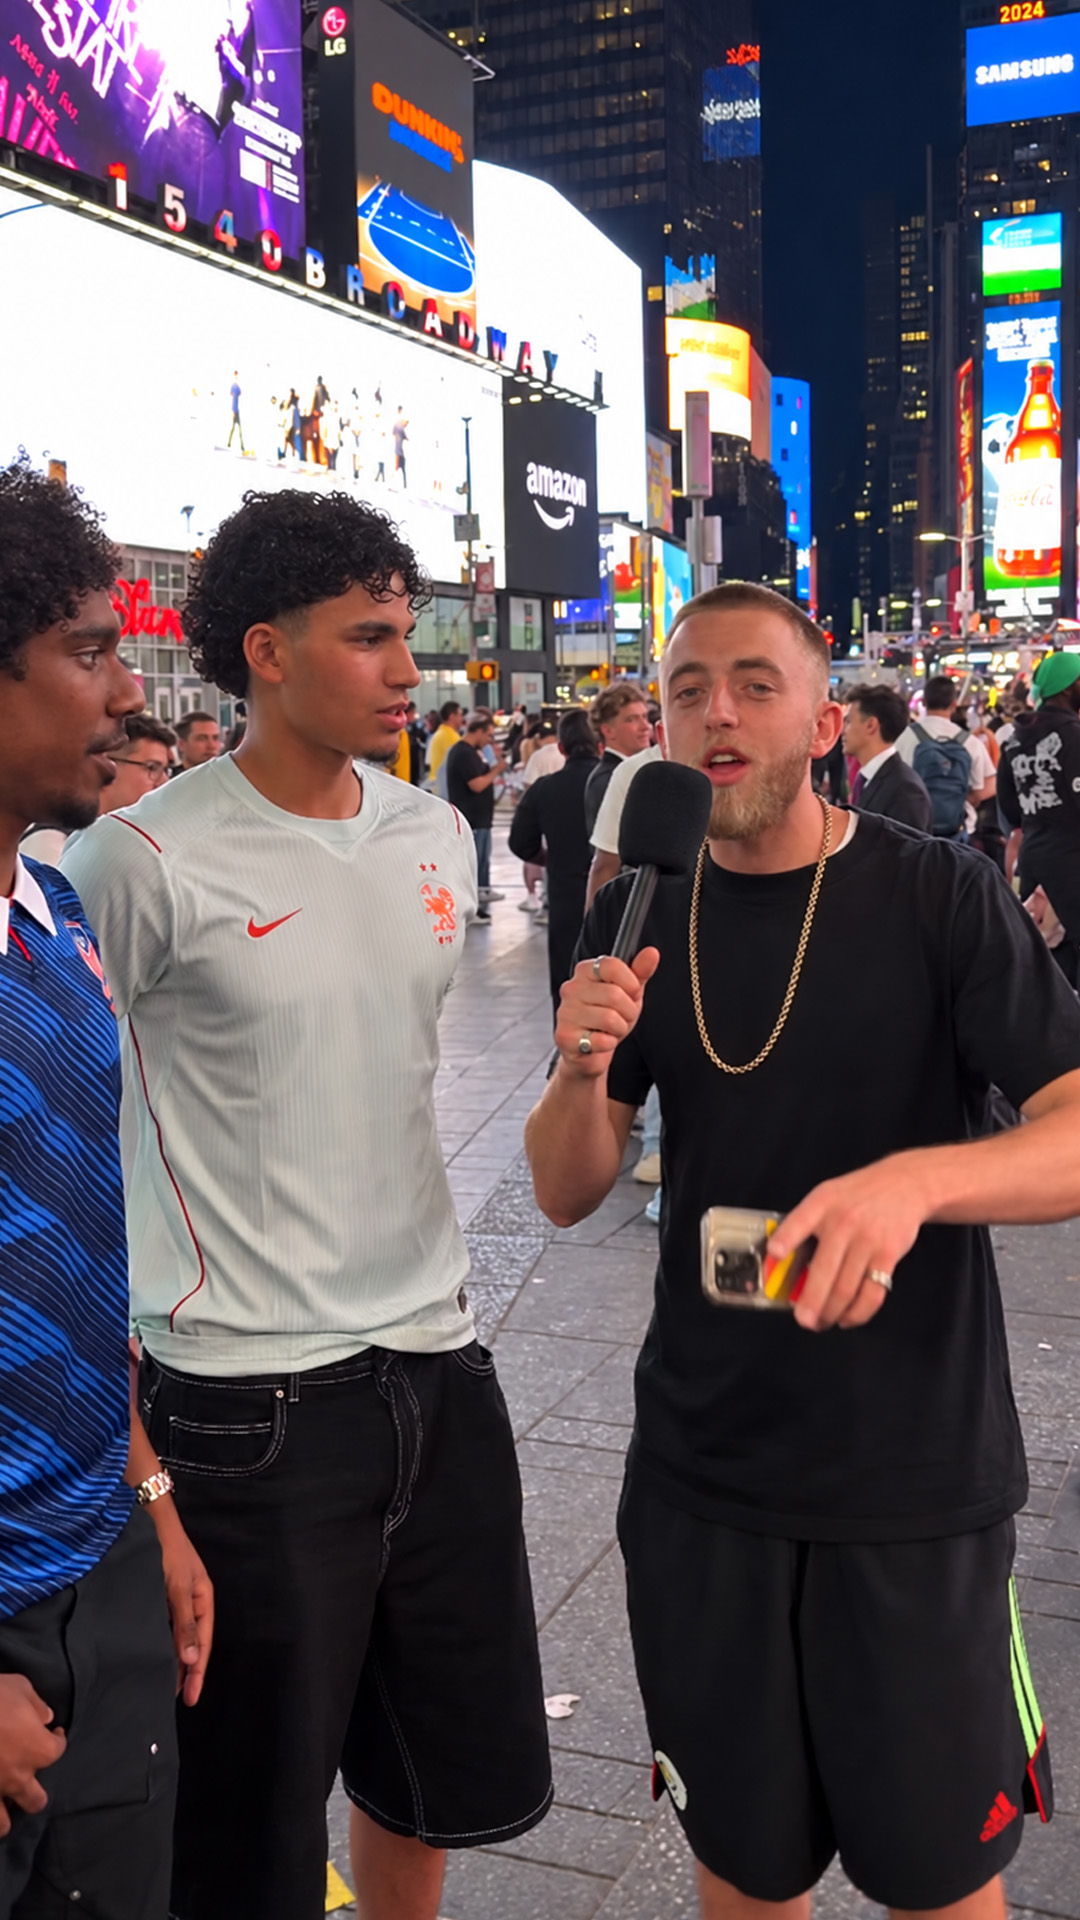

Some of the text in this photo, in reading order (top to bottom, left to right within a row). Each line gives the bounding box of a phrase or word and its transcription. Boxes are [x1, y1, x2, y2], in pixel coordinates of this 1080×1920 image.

[1000, 1, 1045, 23] 2024
[324, 37, 347, 56] LG
[975, 54, 1074, 85] SAMSUNG
[305, 247, 559, 381] BROADWAY
[526, 461, 588, 508] amazon
